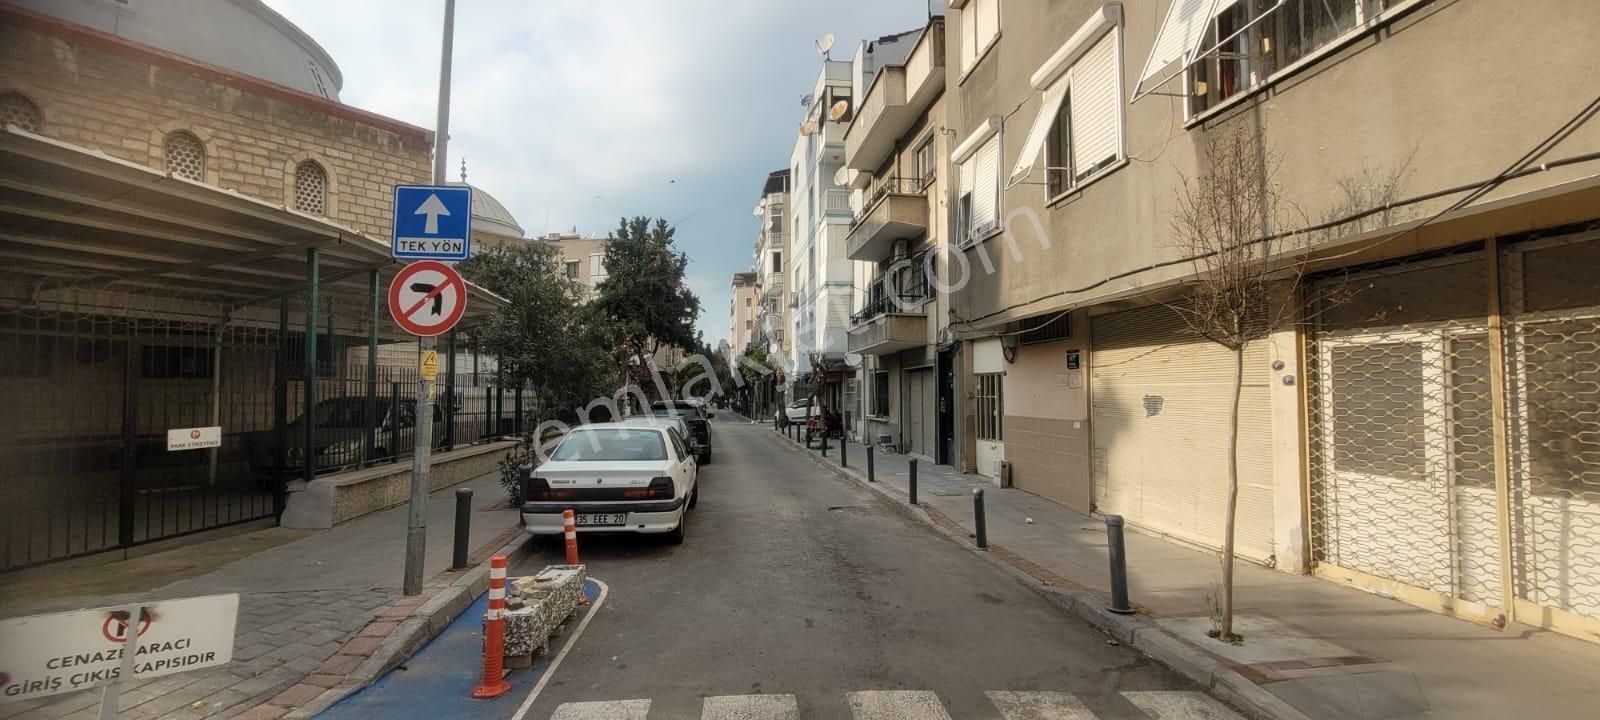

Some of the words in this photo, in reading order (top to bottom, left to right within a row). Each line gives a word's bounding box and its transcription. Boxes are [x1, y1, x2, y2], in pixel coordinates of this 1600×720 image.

[400, 240, 426, 252] TEK
[432, 239, 462, 253] YÖN
[578, 515, 588, 523] 35
[593, 515, 608, 523] EEE
[614, 515, 624, 523] 20
[136, 638, 191, 657] ARACI
[4, 675, 62, 697] GİRİŞ
